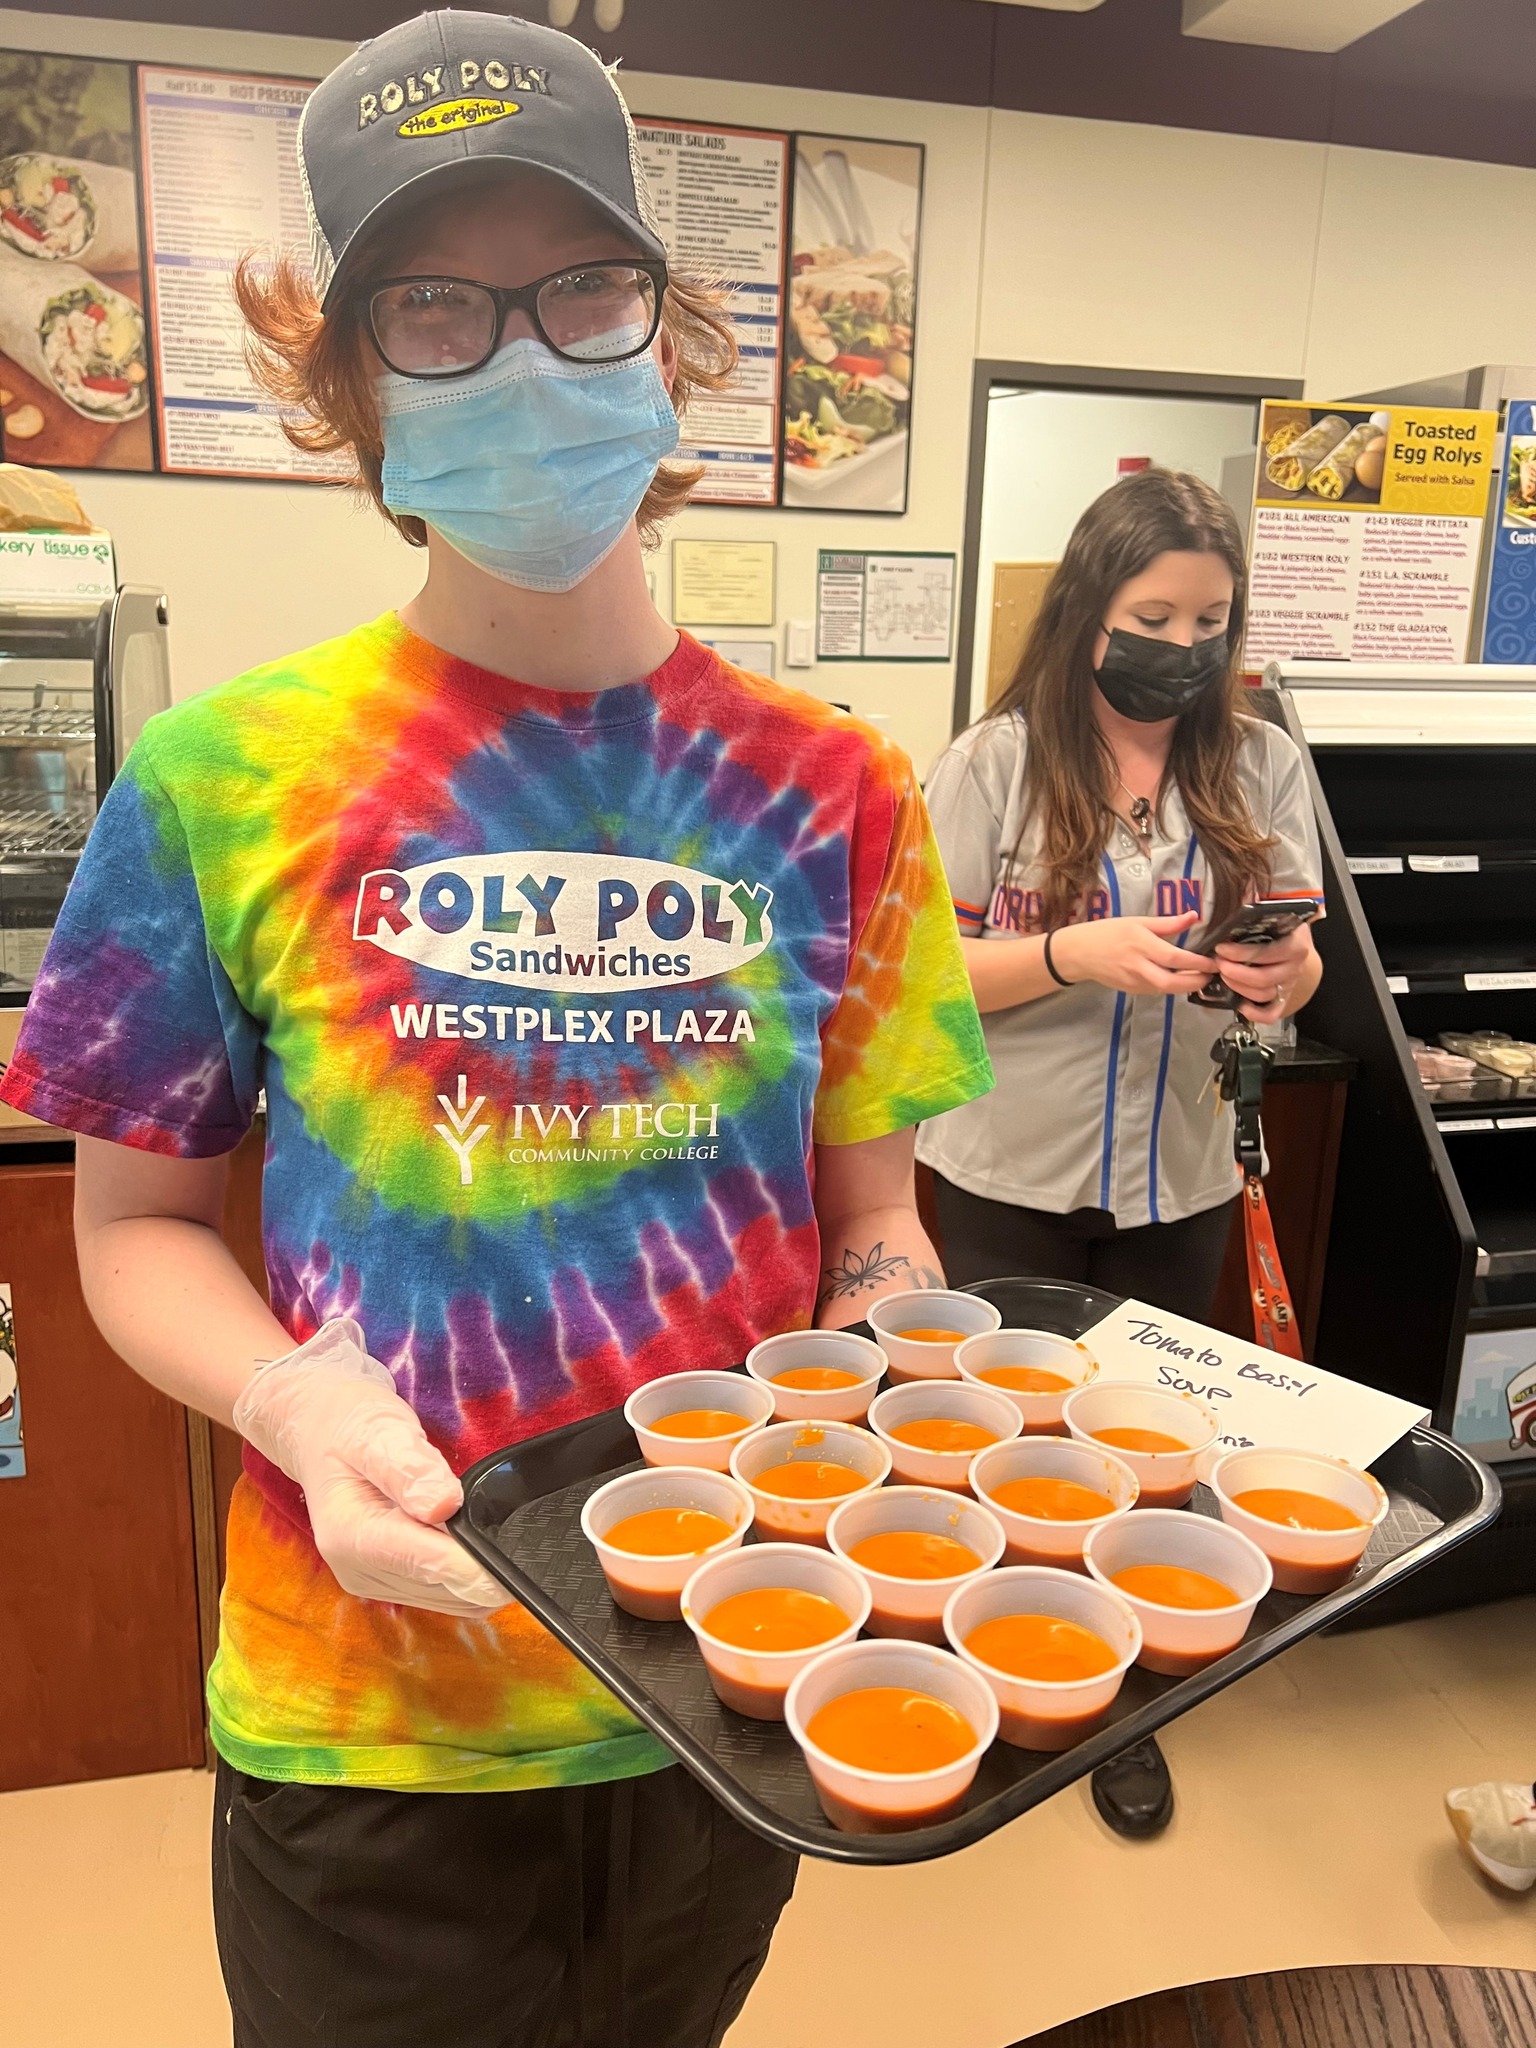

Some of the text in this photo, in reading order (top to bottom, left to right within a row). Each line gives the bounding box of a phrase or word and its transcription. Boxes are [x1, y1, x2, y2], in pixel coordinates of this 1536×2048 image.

[358, 59, 552, 131] ROLY POLY
[405, 100, 506, 133] the original
[1404, 421, 1477, 441] Toasted
[1393, 443, 1482, 467] Egg Rolys
[1394, 472, 1476, 486] Served with Salsa
[1302, 512, 1350, 523] AMERICAN
[43, 540, 89, 555] tissue
[1280, 552, 1324, 563] WESTERN
[1402, 572, 1450, 581] SCRAMBLE
[1305, 611, 1350, 622] SCRAMBLE
[355, 870, 770, 947] ROLY POLY
[469, 941, 692, 977] Sandwiches
[390, 1004, 757, 1043] WESTPLEX PLAZA
[511, 1103, 721, 1140] IVY TECH
[509, 1145, 719, 1164] COMMUNITY COLLEGE
[1127, 1319, 1223, 1367] Tomato
